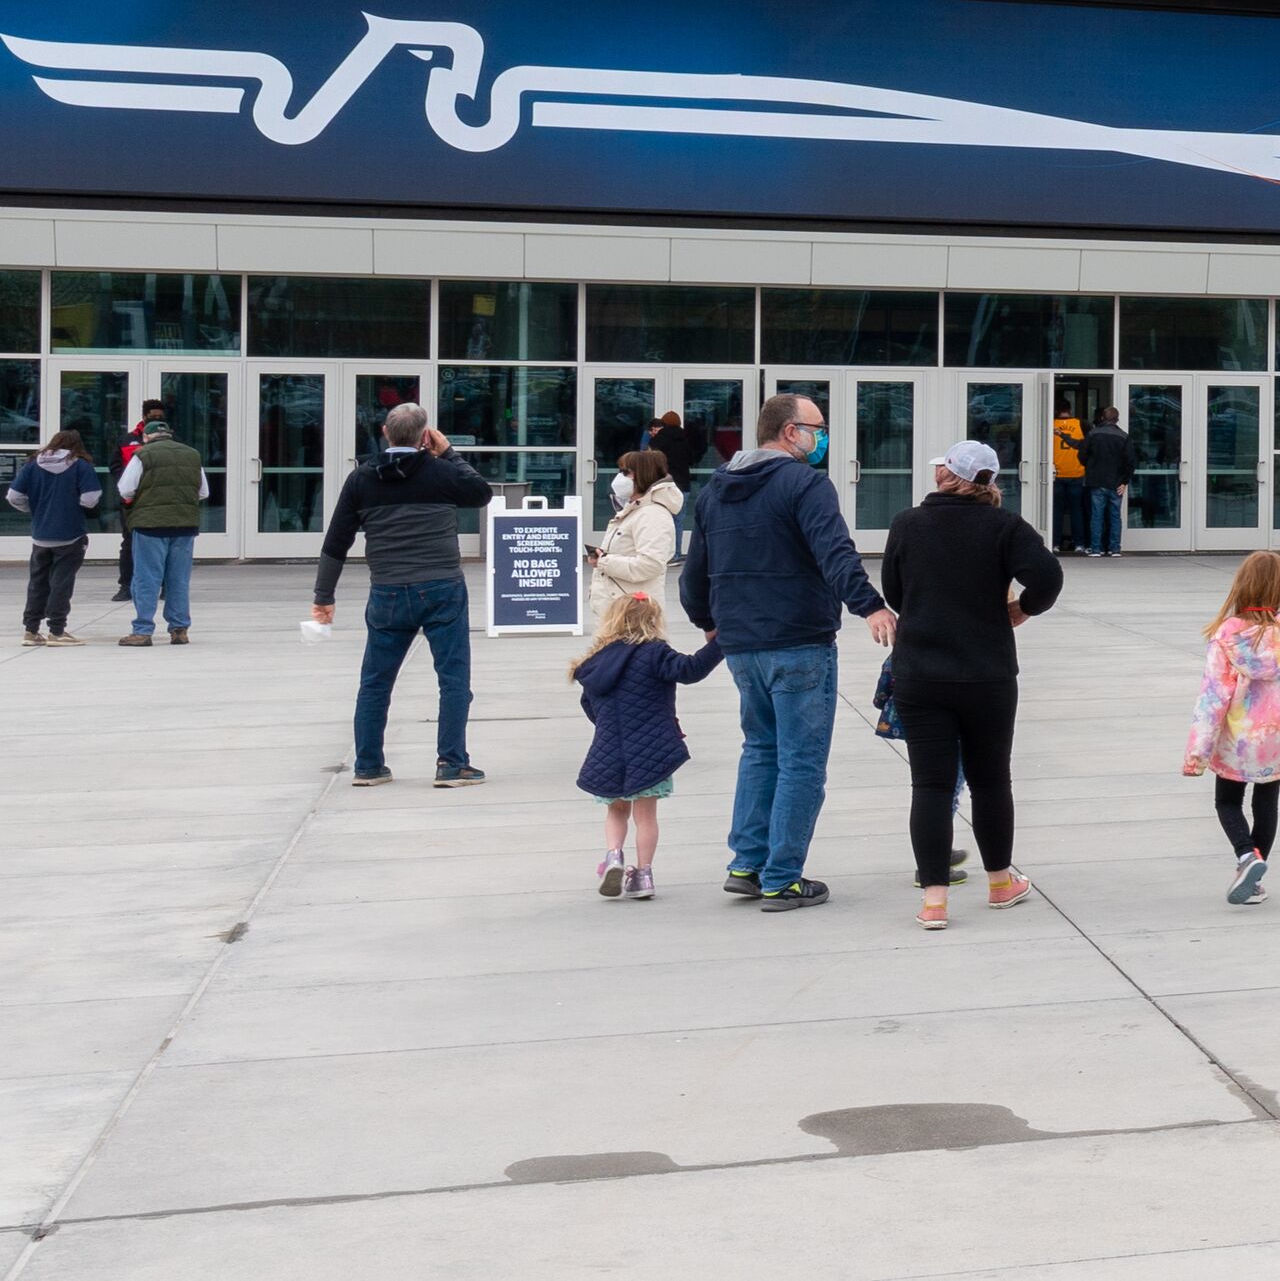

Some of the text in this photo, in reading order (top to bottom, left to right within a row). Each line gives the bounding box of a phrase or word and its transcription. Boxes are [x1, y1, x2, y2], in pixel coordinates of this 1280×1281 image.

[513, 559, 558, 569] NO BAGS
[511, 569, 561, 578] ALLOWED
[519, 578, 553, 588] INSIDE
